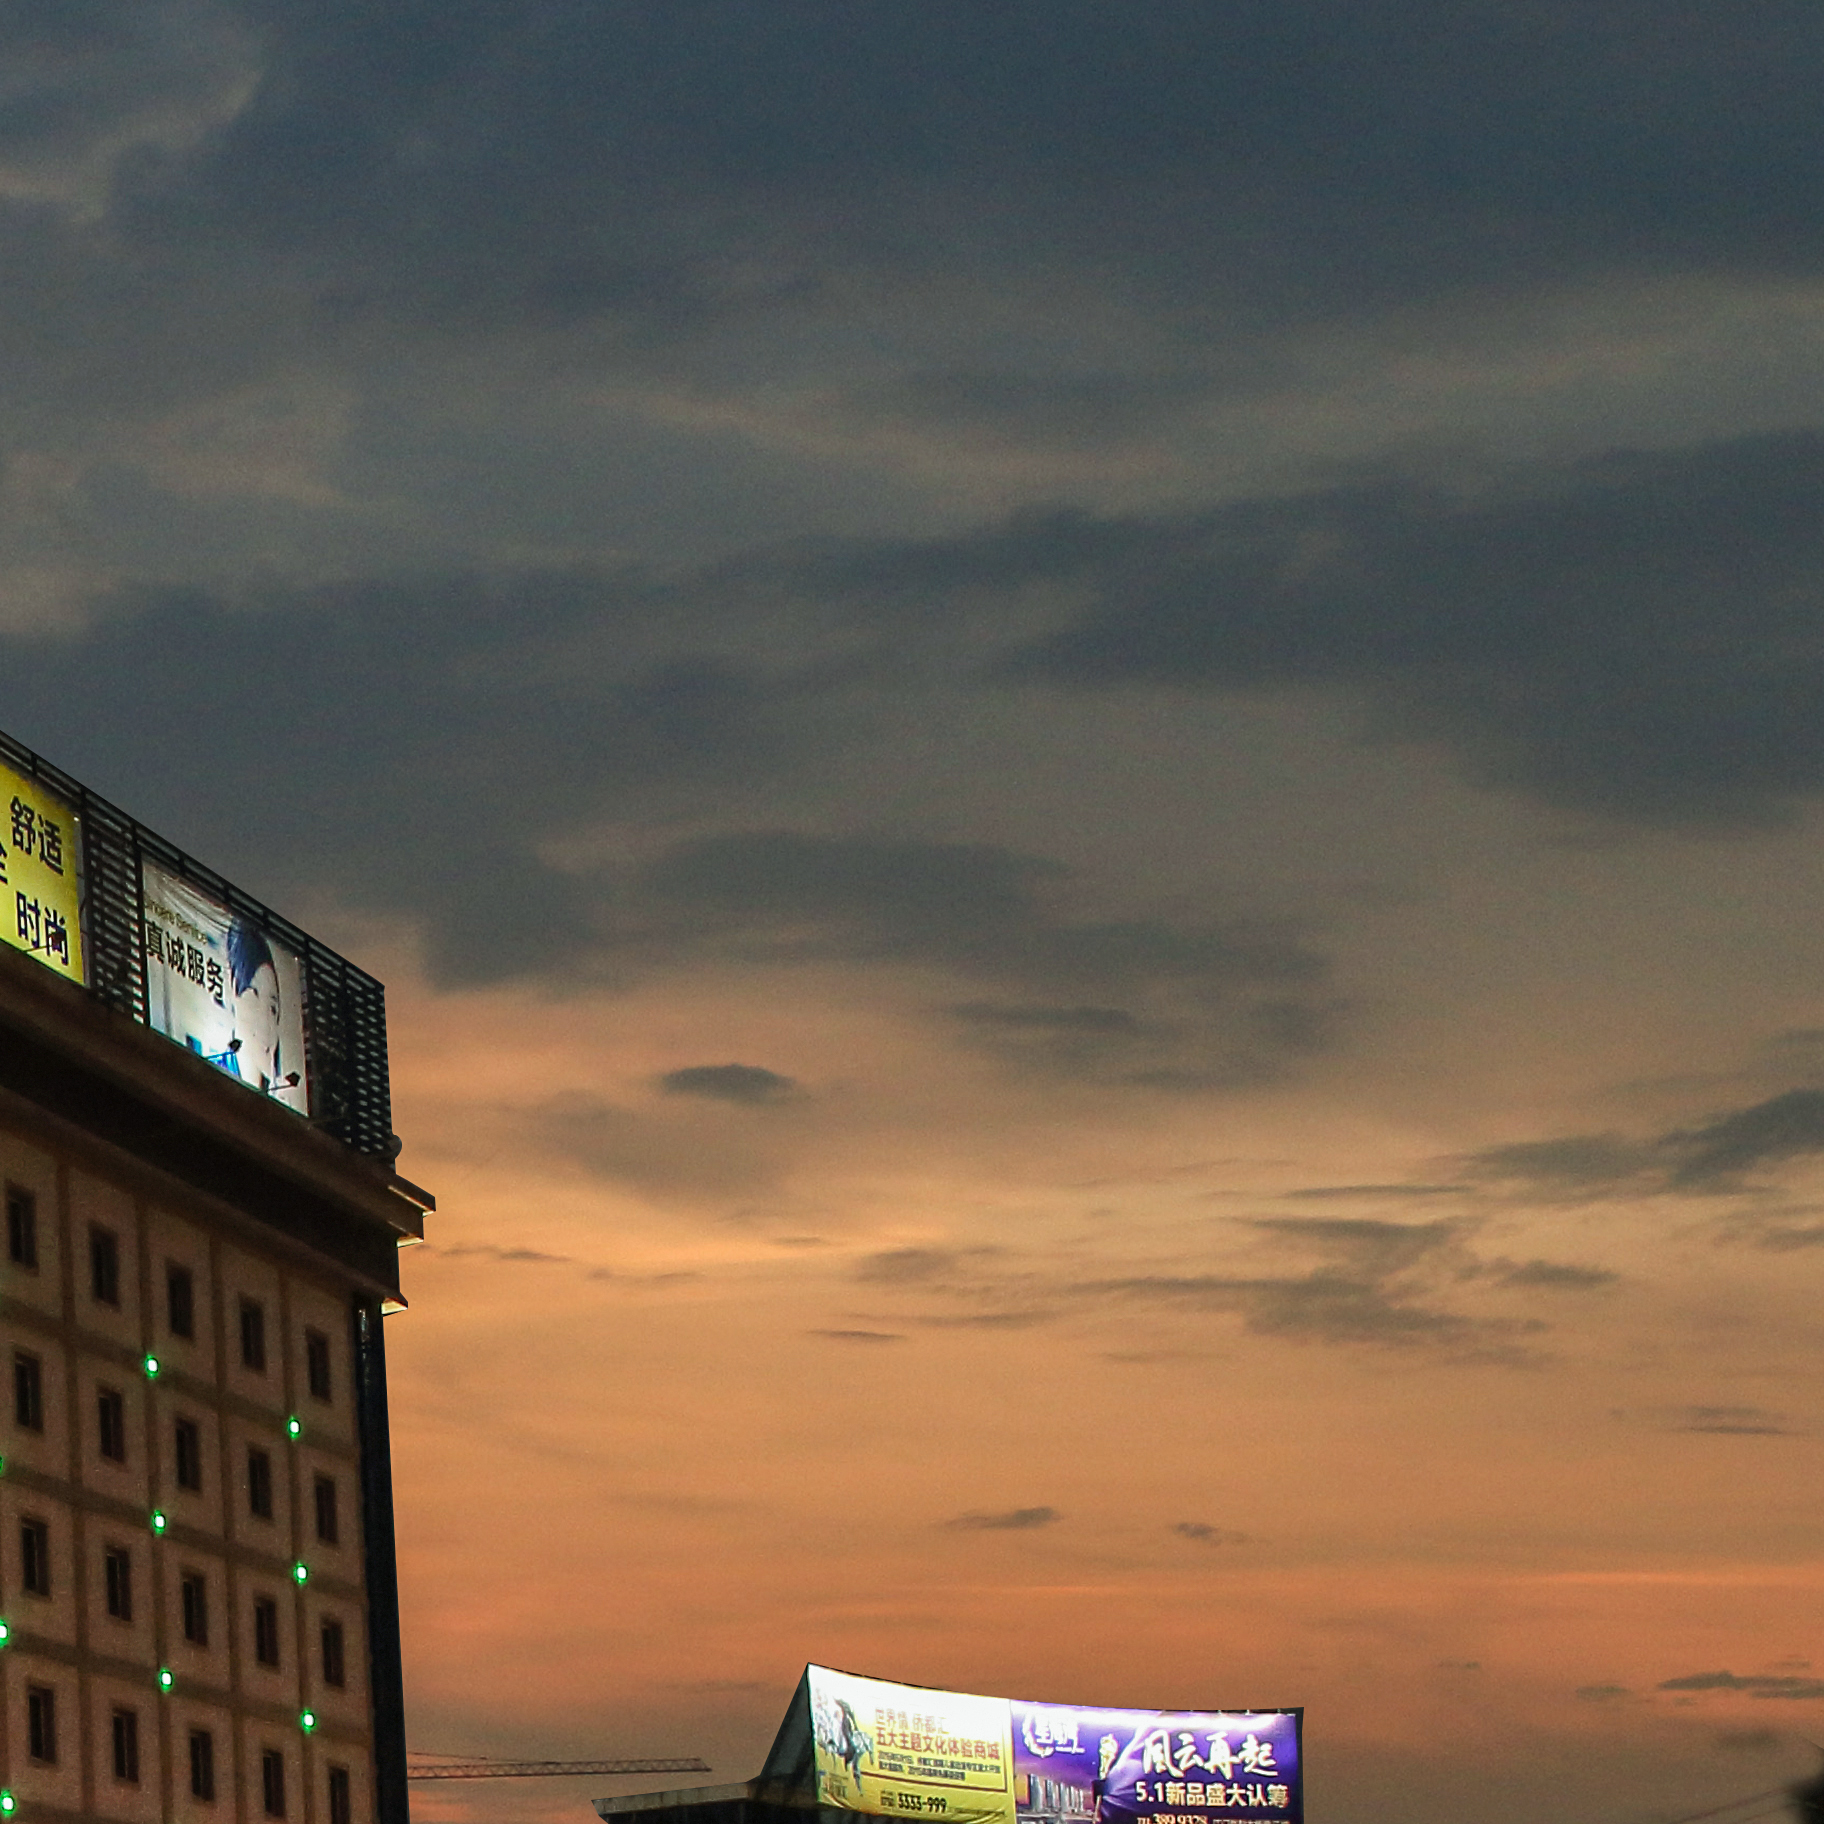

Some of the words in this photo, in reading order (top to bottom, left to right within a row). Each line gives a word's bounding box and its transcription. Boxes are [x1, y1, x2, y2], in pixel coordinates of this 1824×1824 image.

[10, 796, 64, 876] 舒适
[15, 890, 69, 967] 时尚
[144, 920, 227, 1010] 真诚服务
